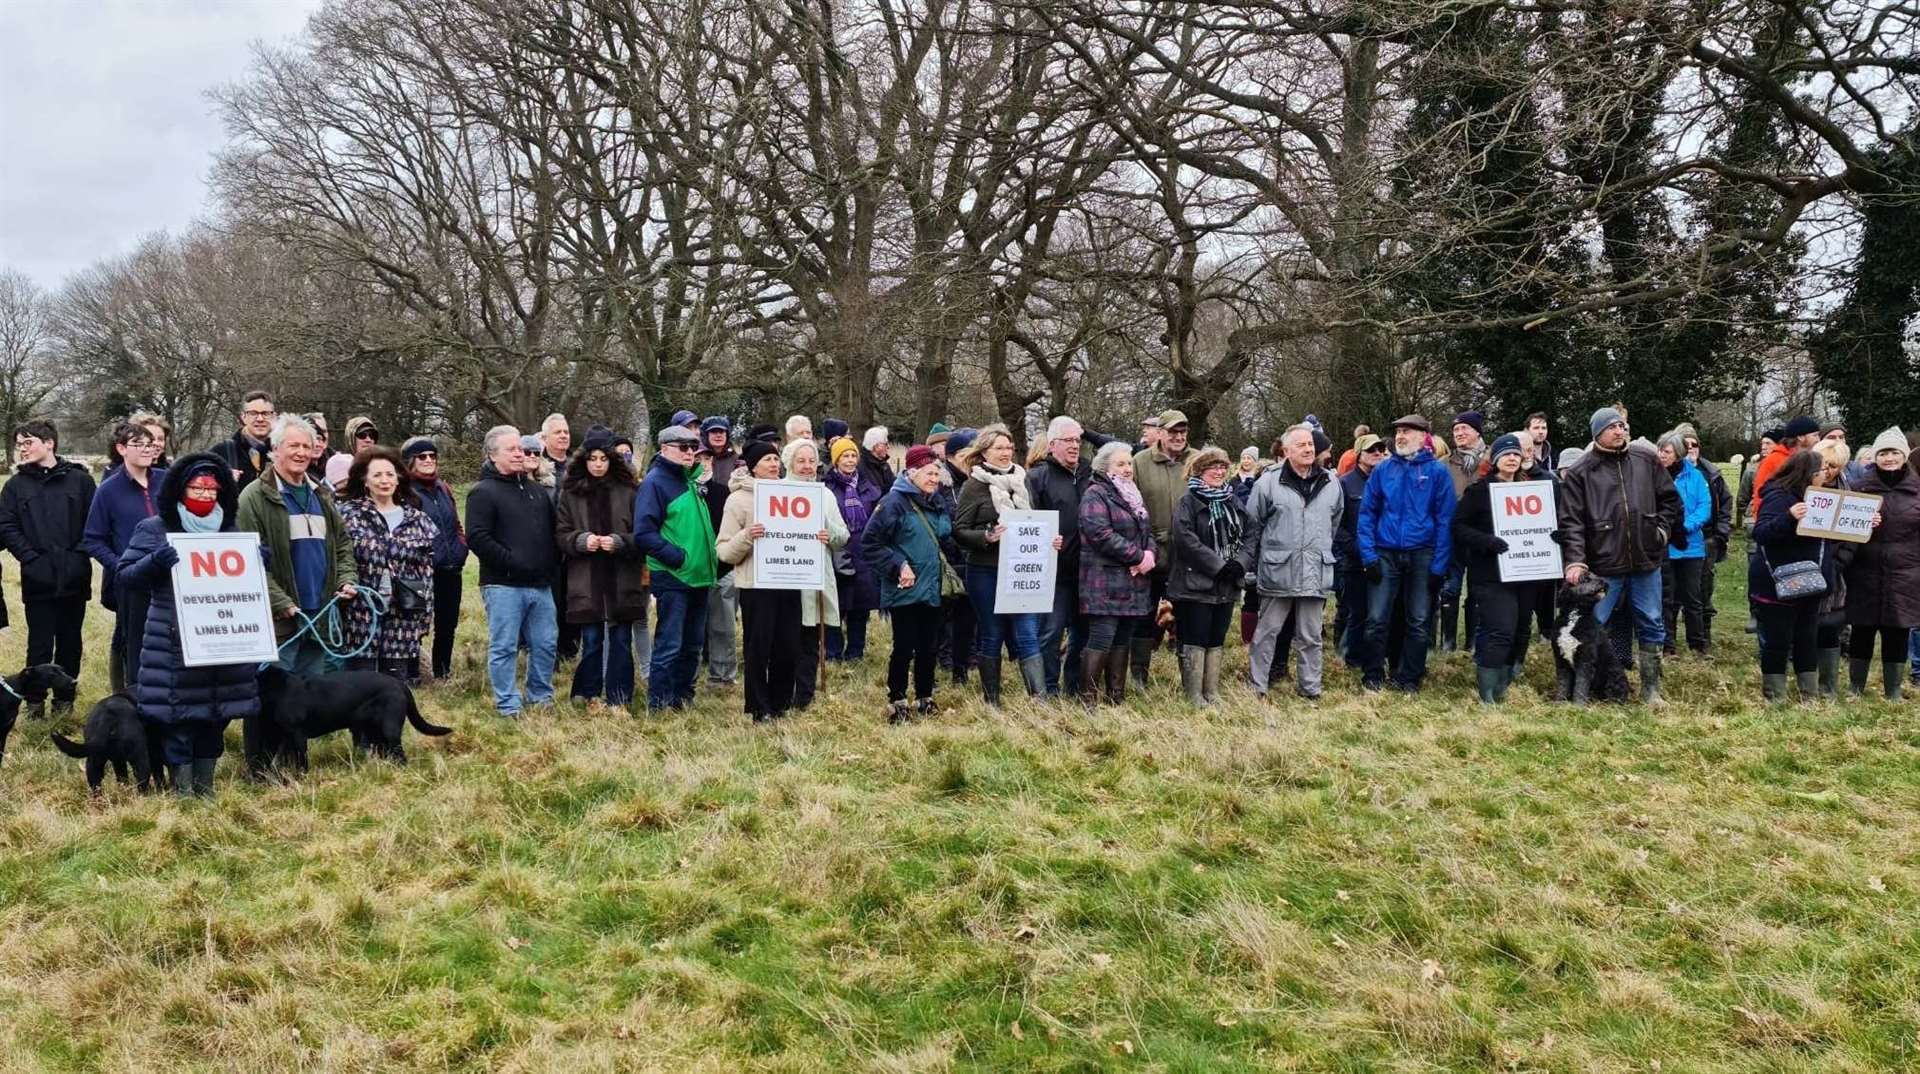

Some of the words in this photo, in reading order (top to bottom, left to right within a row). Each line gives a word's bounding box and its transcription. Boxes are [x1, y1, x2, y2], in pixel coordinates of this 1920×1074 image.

[770, 496, 810, 518] NO
[1506, 494, 1542, 516] NO
[1811, 496, 1834, 510] STOP
[1811, 516, 1824, 526] THE
[1838, 517, 1849, 527] OF
[1852, 518, 1872, 530] KENT
[1018, 526, 1040, 536] SAVE
[1500, 527, 1552, 536] DEVELOPMENT
[1020, 544, 1038, 554] OUR
[190, 550, 245, 577] NO
[792, 558, 814, 566] LAND
[1014, 564, 1042, 572] GREEN
[1013, 580, 1040, 590] FIELDS
[183, 592, 260, 604] DEVELOPMENT
[218, 609, 234, 619] ON
[194, 625, 229, 636] LIMES
[232, 624, 260, 634] LAND
